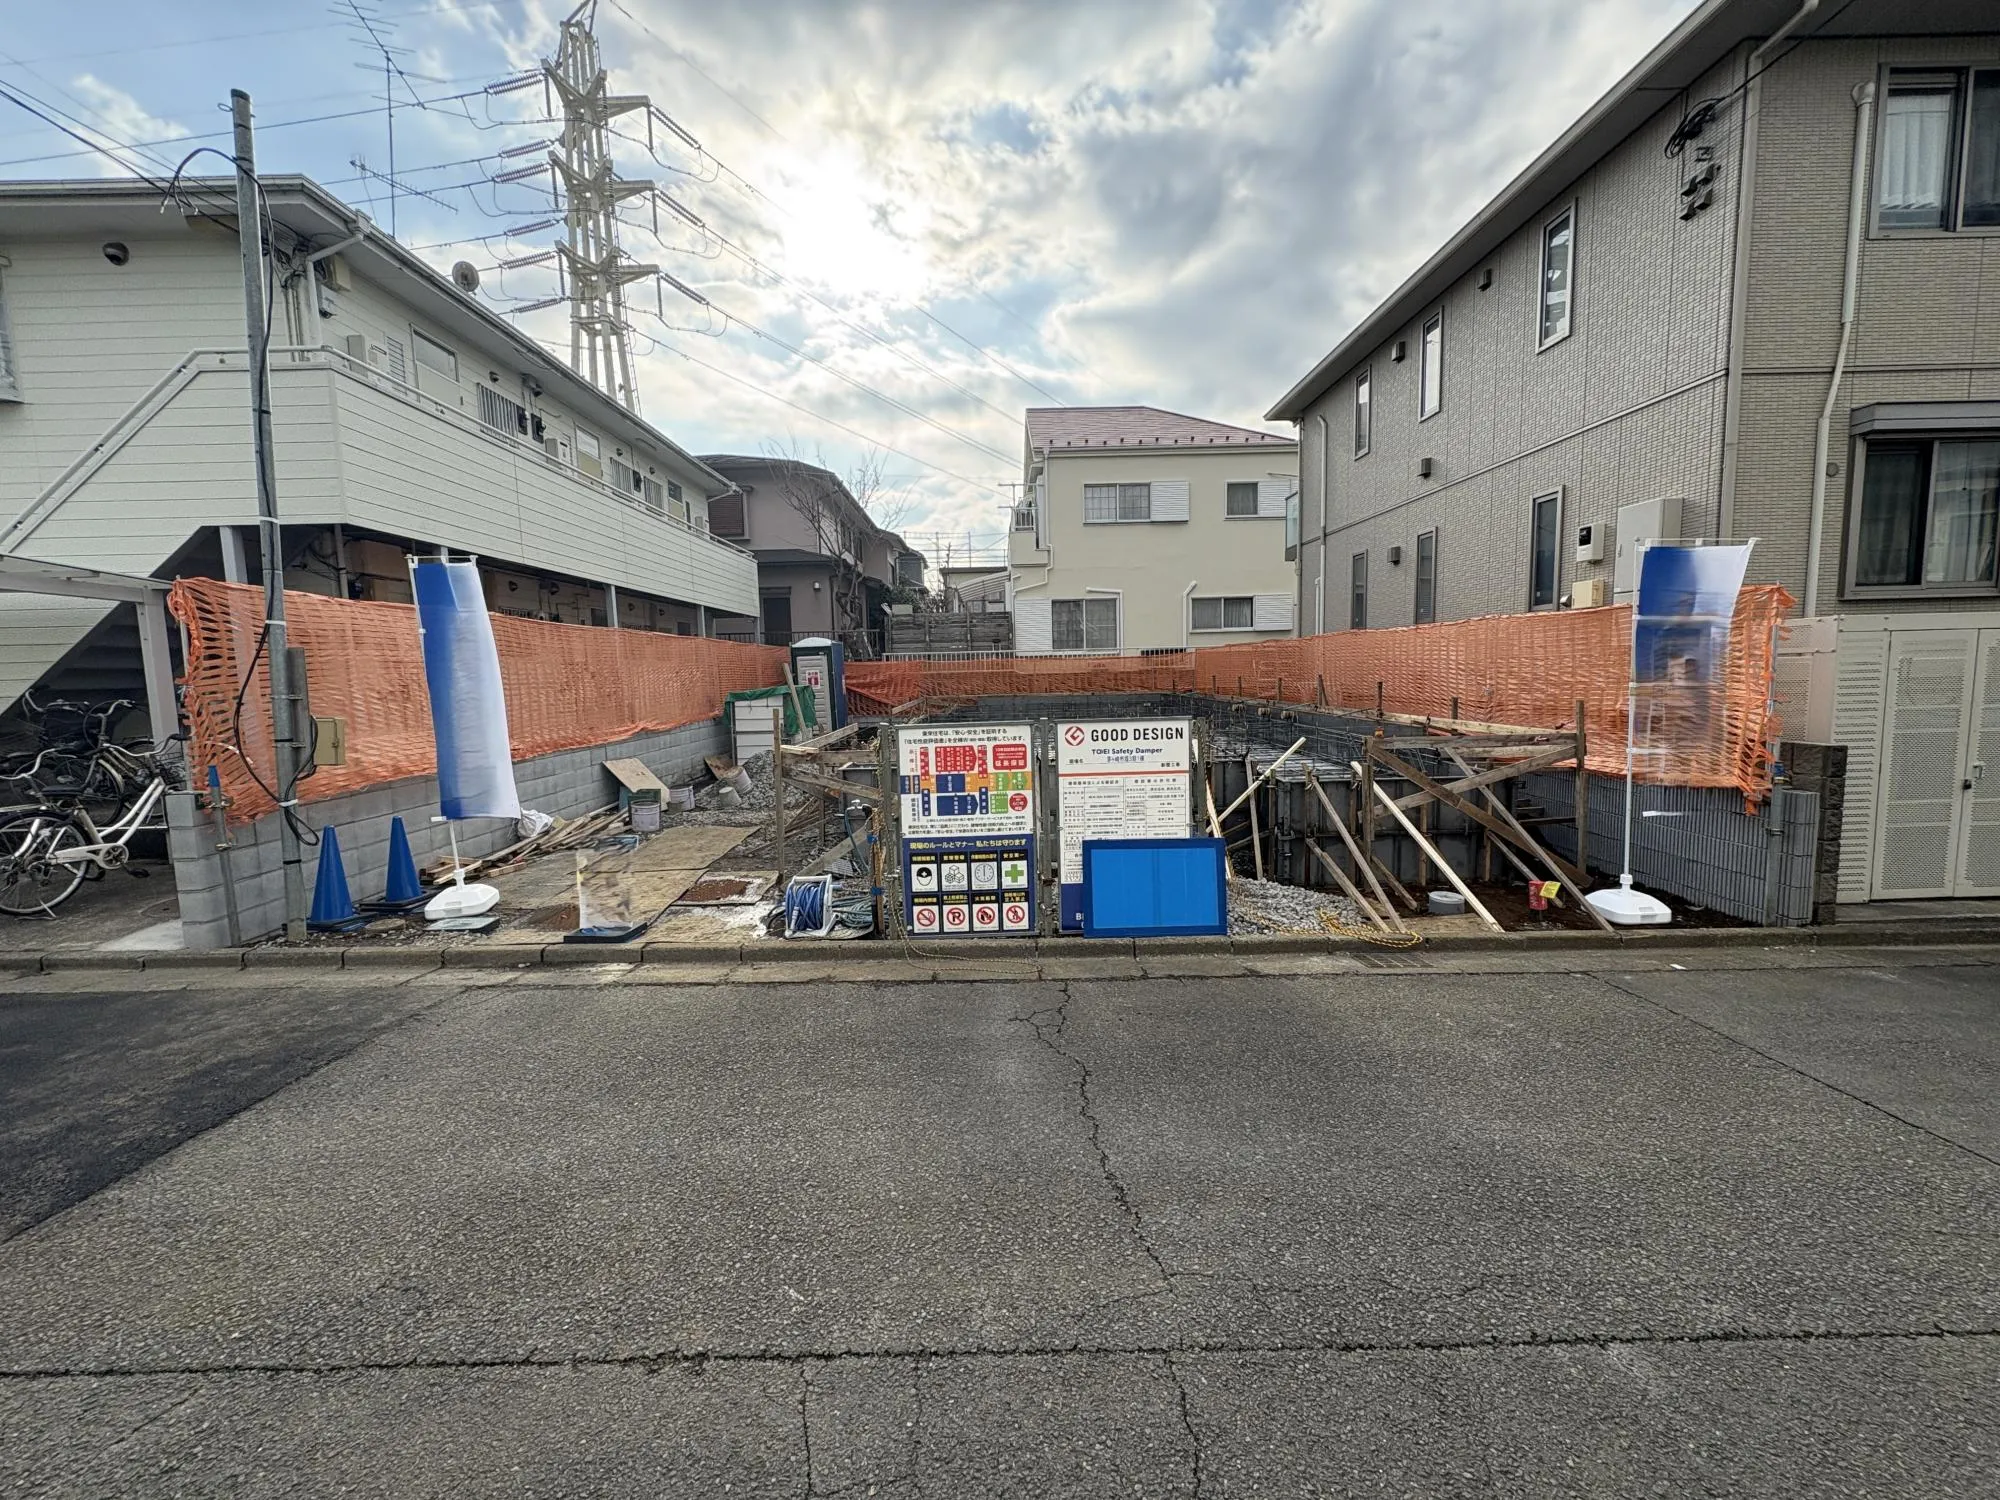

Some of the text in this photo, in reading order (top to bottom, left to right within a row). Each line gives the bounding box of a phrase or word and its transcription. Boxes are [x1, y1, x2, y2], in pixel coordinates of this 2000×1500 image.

[1091, 727, 1183, 742] GOOD DESIGN
[1112, 748, 1133, 756] Safety
[1136, 747, 1163, 755] Damper
[976, 839, 1026, 848] 私たちは守ります
